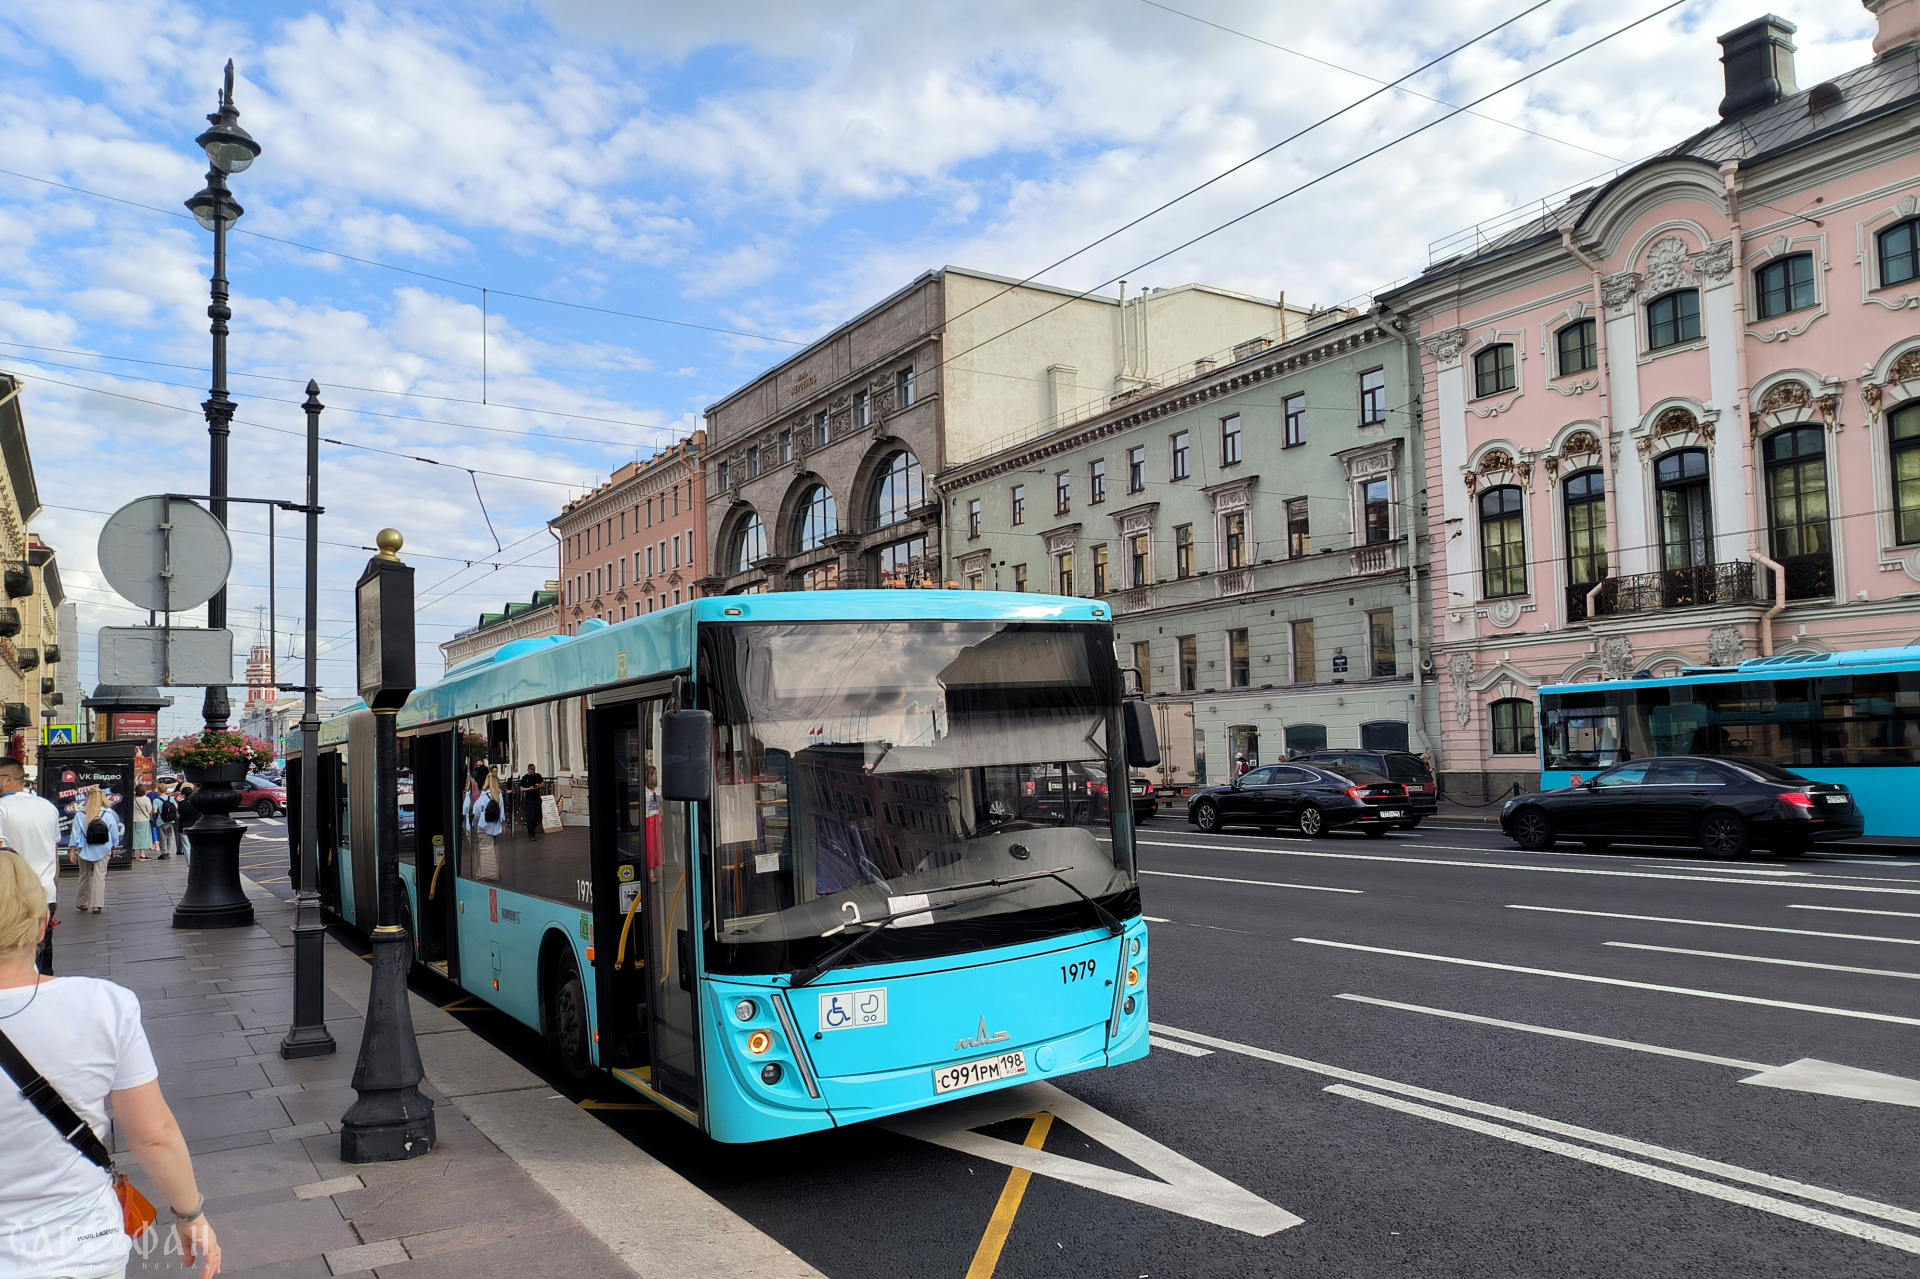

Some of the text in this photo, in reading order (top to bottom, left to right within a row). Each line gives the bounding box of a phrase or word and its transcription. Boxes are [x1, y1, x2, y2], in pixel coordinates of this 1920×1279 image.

[93, 773, 122, 781] Видео
[59, 789, 78, 798] ЕСТЬ
[1060, 958, 1096, 985] 1979
[941, 1053, 1023, 1089] С991РМ 198
